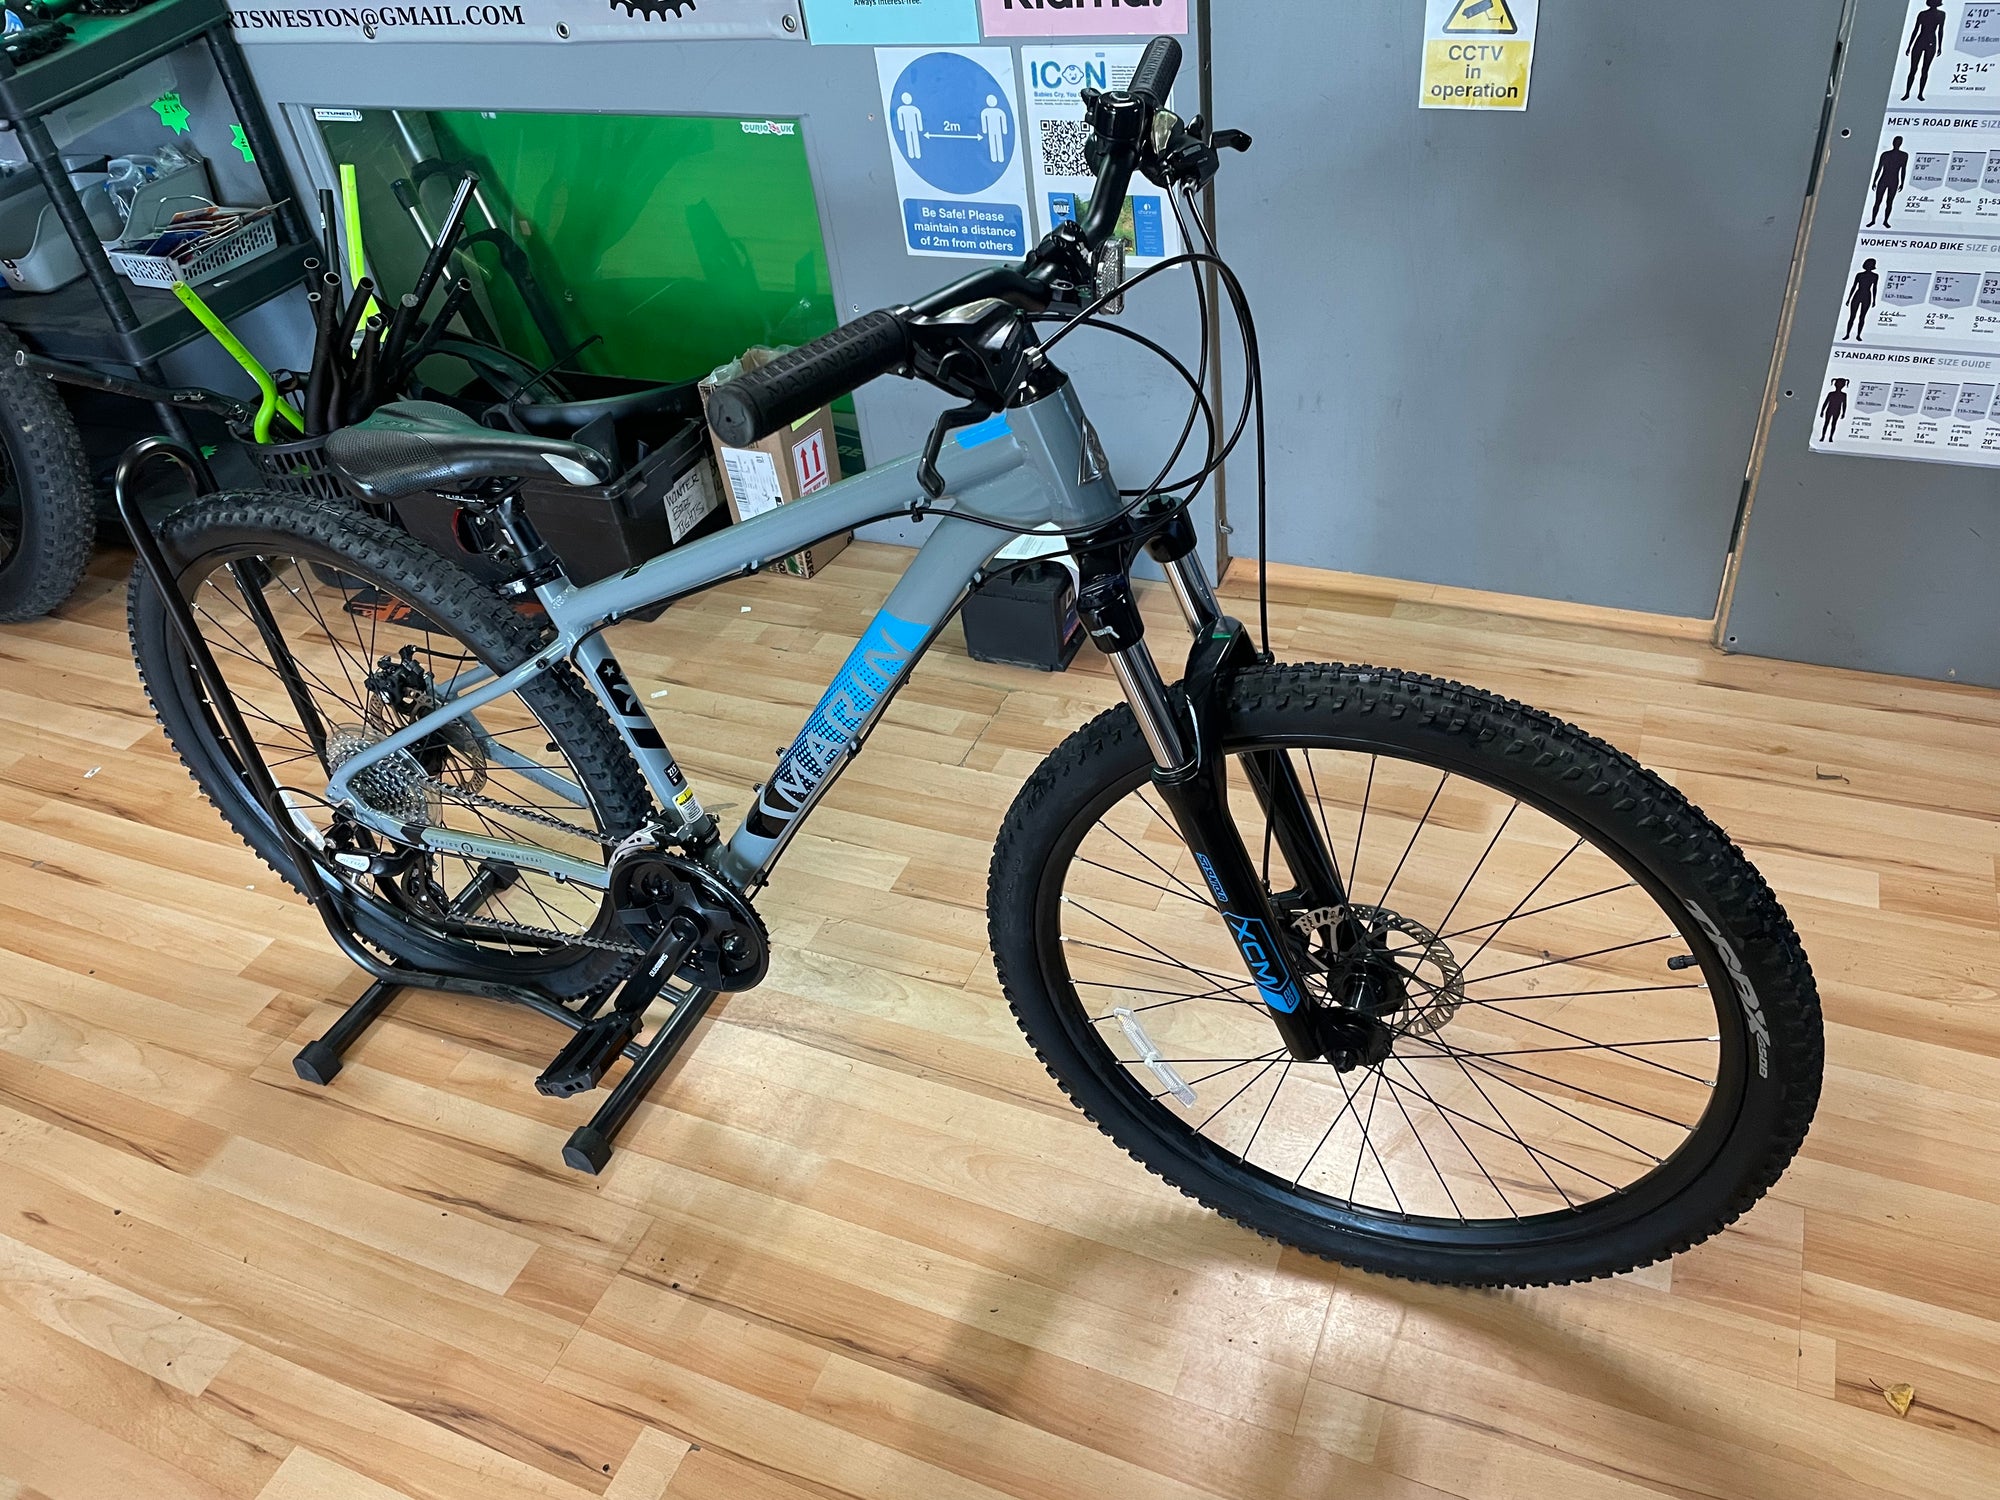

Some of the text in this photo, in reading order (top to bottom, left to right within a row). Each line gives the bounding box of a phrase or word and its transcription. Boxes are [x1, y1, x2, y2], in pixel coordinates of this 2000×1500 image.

[1449, 45, 1503, 61] CCTV
[1465, 64, 1481, 79] in
[1956, 63, 1995, 72] 13-14"
[1951, 74, 1967, 83] XS
[1431, 83, 1518, 100] operation
[943, 120, 961, 132] 2m
[1887, 117, 1920, 126] MEN'S
[1922, 118, 1950, 127] ROAD
[1953, 119, 1978, 128] BIKE
[922, 207, 1005, 222] Be Safe! Please
[914, 222, 1017, 237] maintain a distance
[920, 236, 1014, 252] of 2m from others
[1860, 238, 1907, 248] WOMEN'S
[1909, 240, 1937, 249] ROAD
[1939, 242, 1964, 251] BIKE
[1966, 243, 1988, 252] SIZE
[1834, 350, 1992, 369] STANDARD KIDS BIKE SIZE GUIDE
[774, 628, 912, 805] MARIN
[1230, 919, 1278, 986] XCM
